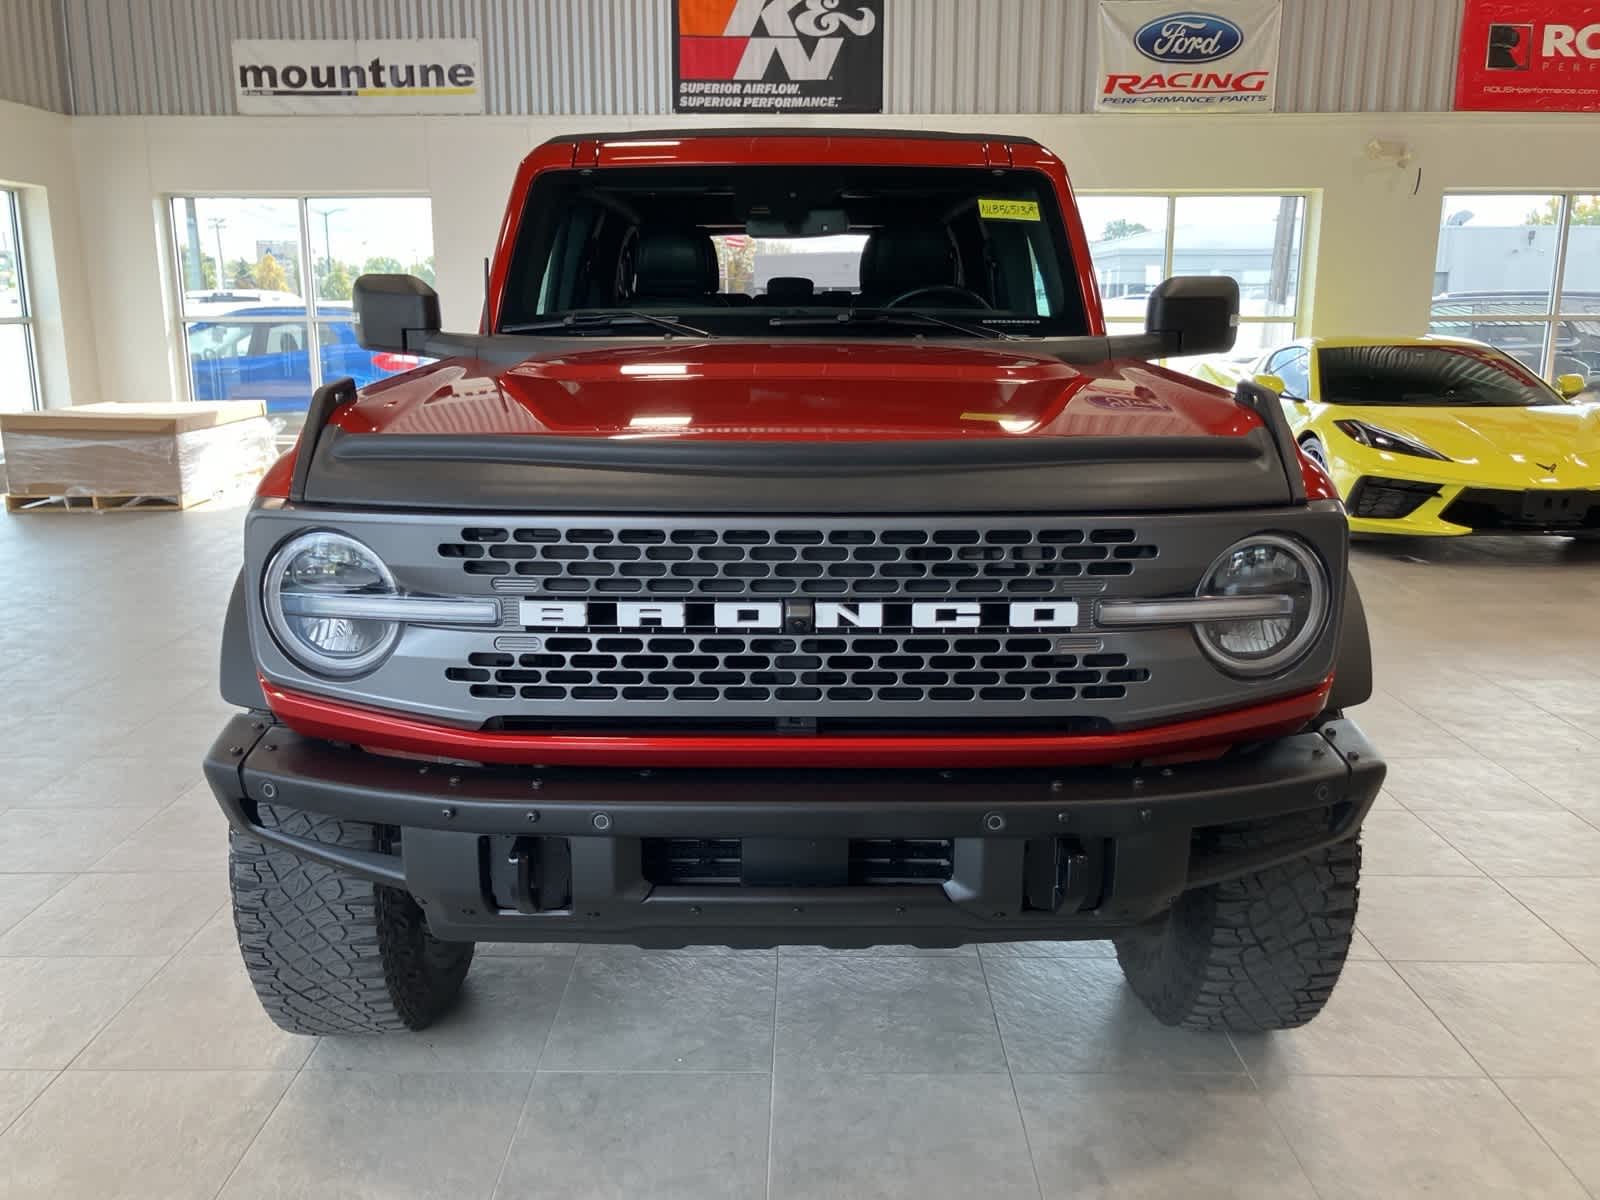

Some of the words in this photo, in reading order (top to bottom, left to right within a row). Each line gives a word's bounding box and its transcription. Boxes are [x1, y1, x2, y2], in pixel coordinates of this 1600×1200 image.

[1154, 21, 1224, 55] Ford
[239, 57, 476, 89] mountune
[1103, 71, 1270, 95] RACING
[679, 82, 741, 94] SUPERIOR
[743, 83, 801, 95] AIRFLOW.
[1102, 96, 1217, 105] PERFORMANCE
[1219, 95, 1268, 103] PARTS
[679, 96, 741, 108] SUPERIOR
[519, 600, 1080, 629] BRONCO
